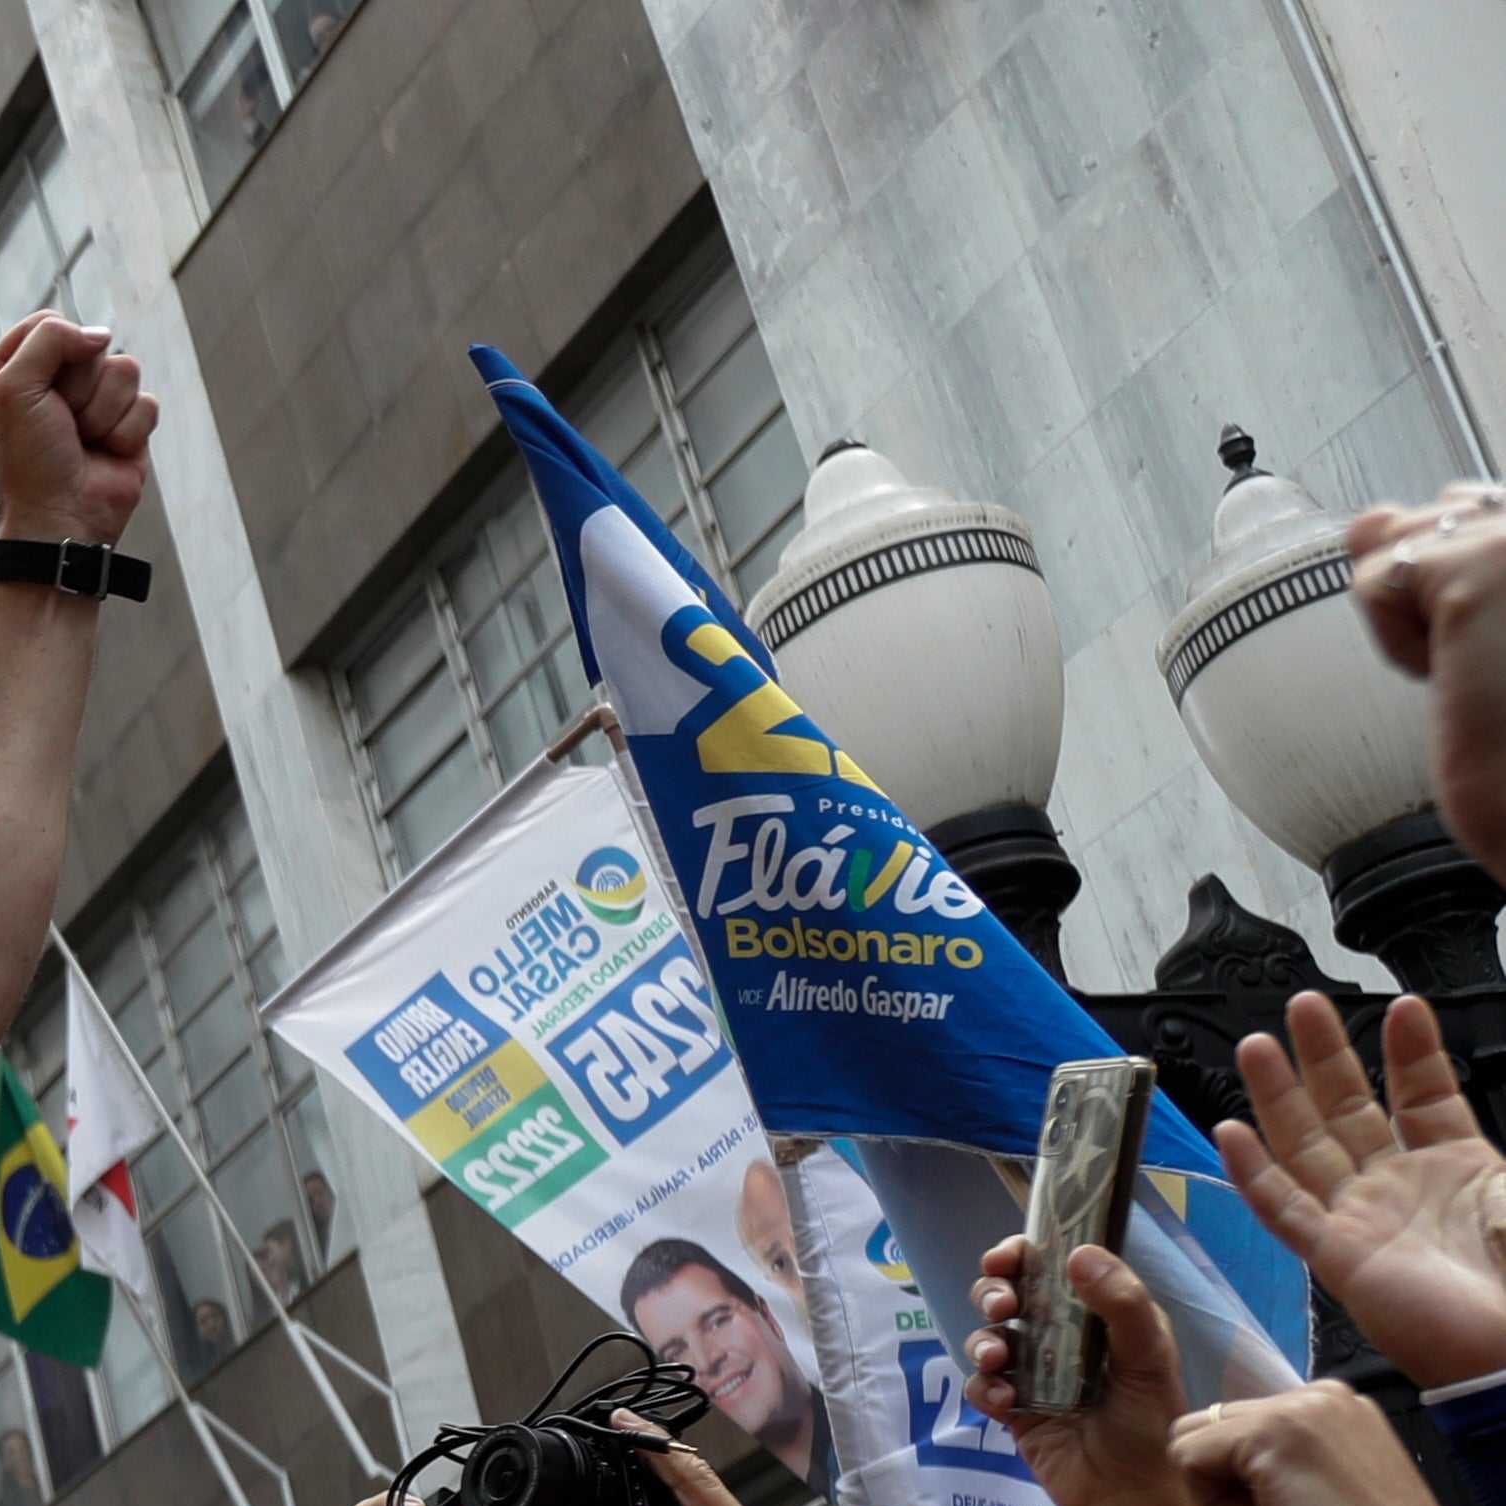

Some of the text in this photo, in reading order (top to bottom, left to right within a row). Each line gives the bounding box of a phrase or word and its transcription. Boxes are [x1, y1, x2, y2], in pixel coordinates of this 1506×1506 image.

[686, 622, 889, 800] 2
[725, 917, 984, 969] Bolsonaro
[766, 971, 857, 1011] Alfredo
[862, 976, 954, 1023] Gaspar
